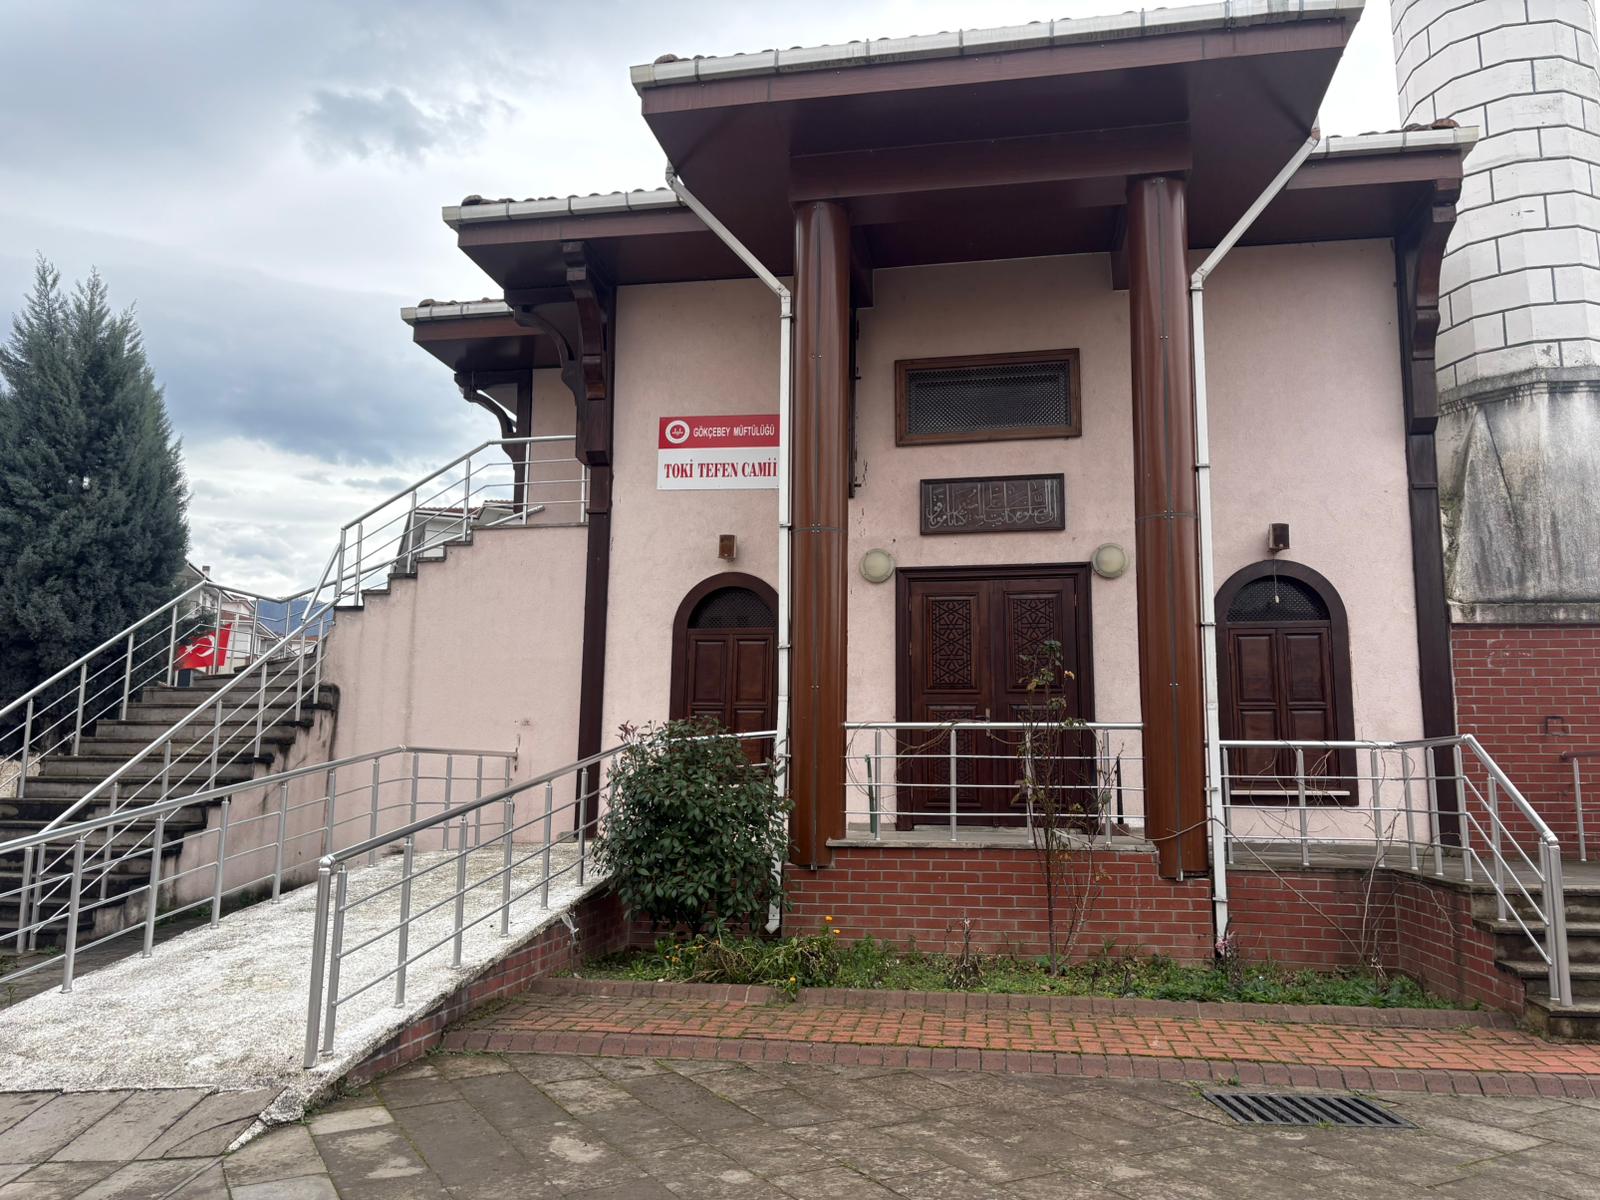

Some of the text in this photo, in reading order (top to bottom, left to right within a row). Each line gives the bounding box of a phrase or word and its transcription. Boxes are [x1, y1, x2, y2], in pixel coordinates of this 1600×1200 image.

[693, 424, 775, 438] GÖKÇEBEY MÜFTÜLÜĞÜ
[664, 458, 777, 478] TOKİ TEFEN CAMİİ
